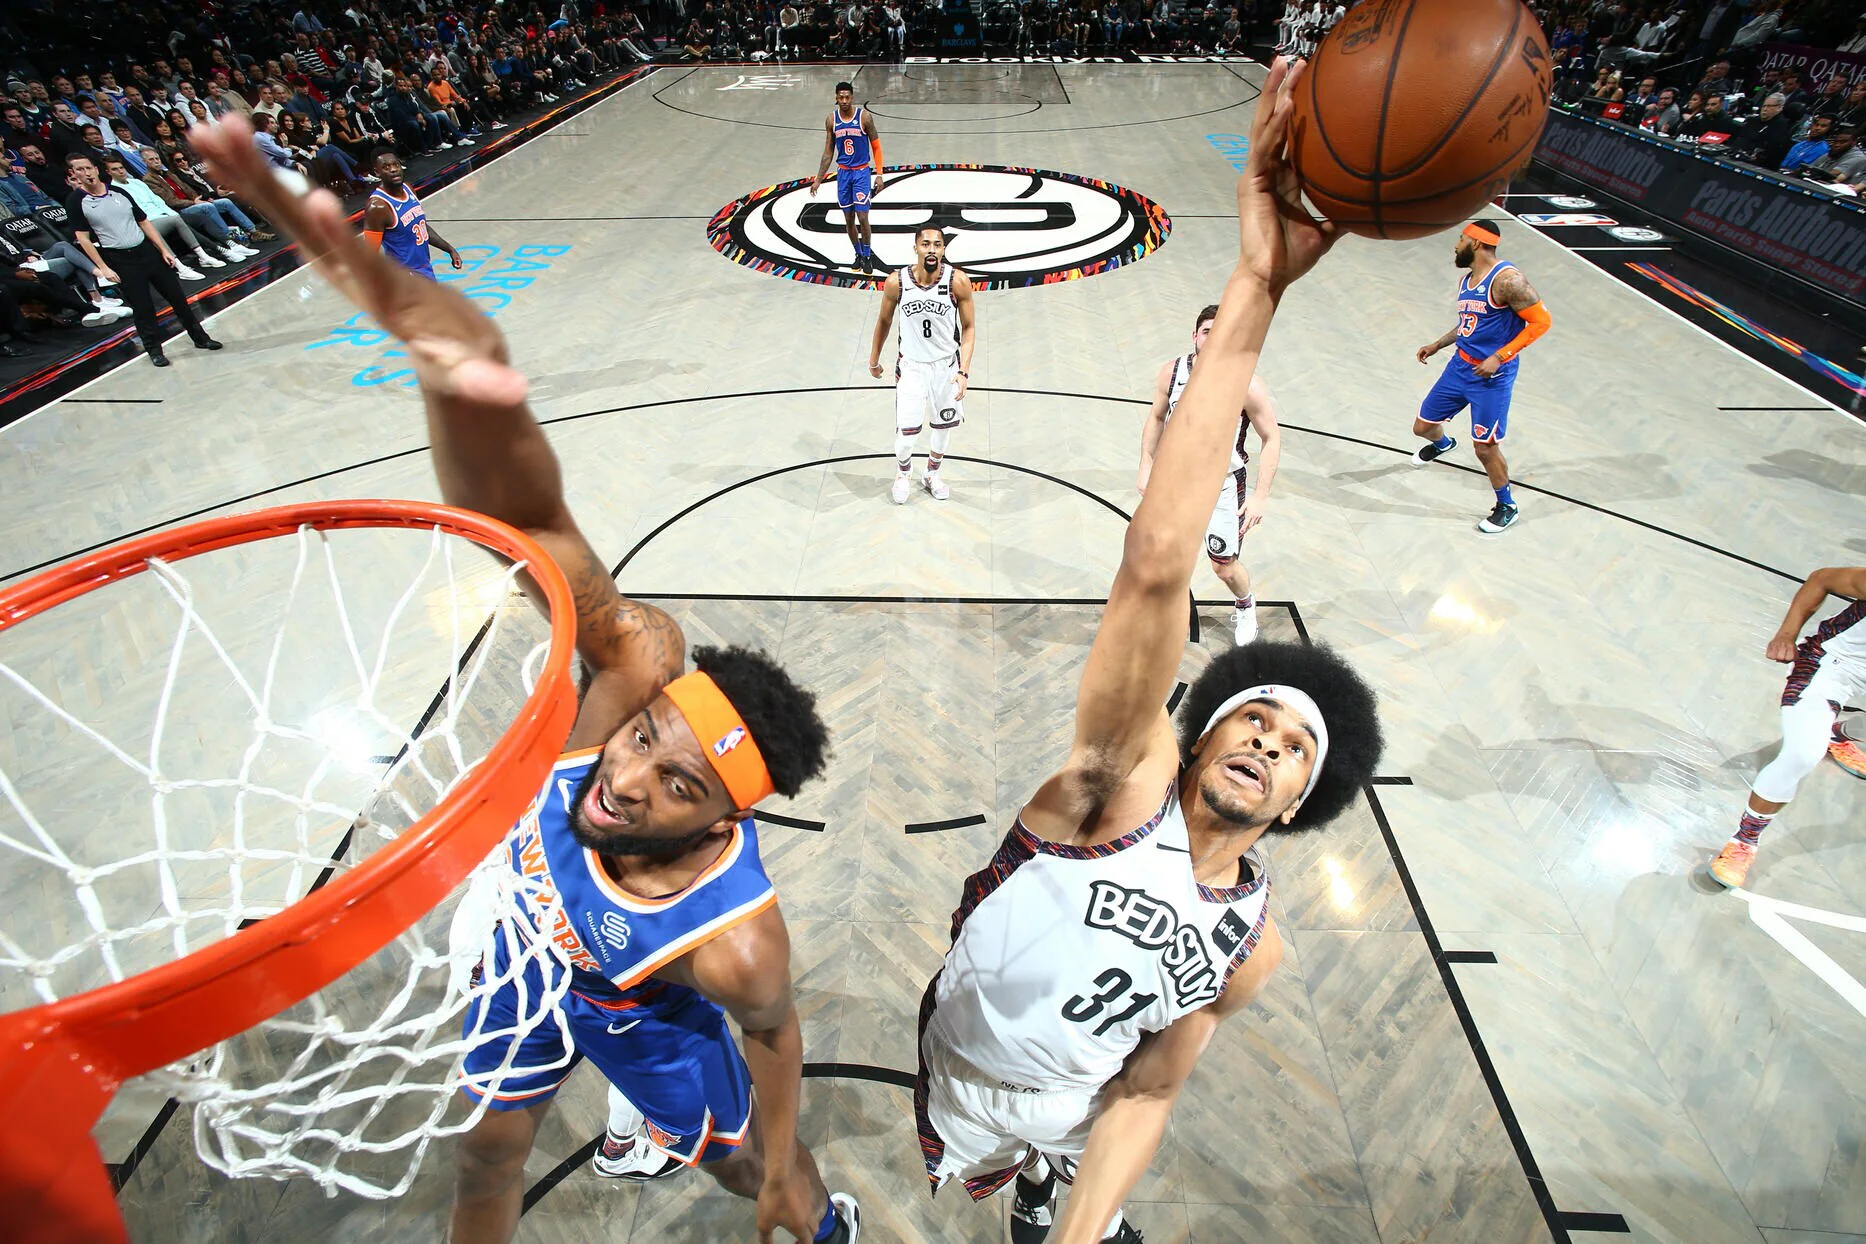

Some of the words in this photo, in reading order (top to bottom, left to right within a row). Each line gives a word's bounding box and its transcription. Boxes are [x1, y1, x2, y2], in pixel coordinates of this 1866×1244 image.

[904, 55, 1126, 63] Brooklyn
[843, 139, 855, 156] 6
[5, 217, 35, 232] QATAR
[43, 207, 67, 220] QATAR
[412, 219, 429, 246] 30
[1686, 212, 1716, 230] Auto
[1716, 225, 1753, 248] Parts
[1754, 239, 1803, 266] Super
[1690, 180, 1763, 227] Parts
[1750, 194, 1866, 277] Authorit
[351, 244, 573, 387] BARCS
[902, 298, 951, 317] BED-STUY
[922, 319, 932, 338] 8
[1457, 313, 1478, 338] 13
[585, 910, 612, 964] SQUARESPACE
[1084, 879, 1217, 1009] BED-STUY
[1217, 917, 1241, 944] infor
[1061, 967, 1159, 1037] 31
